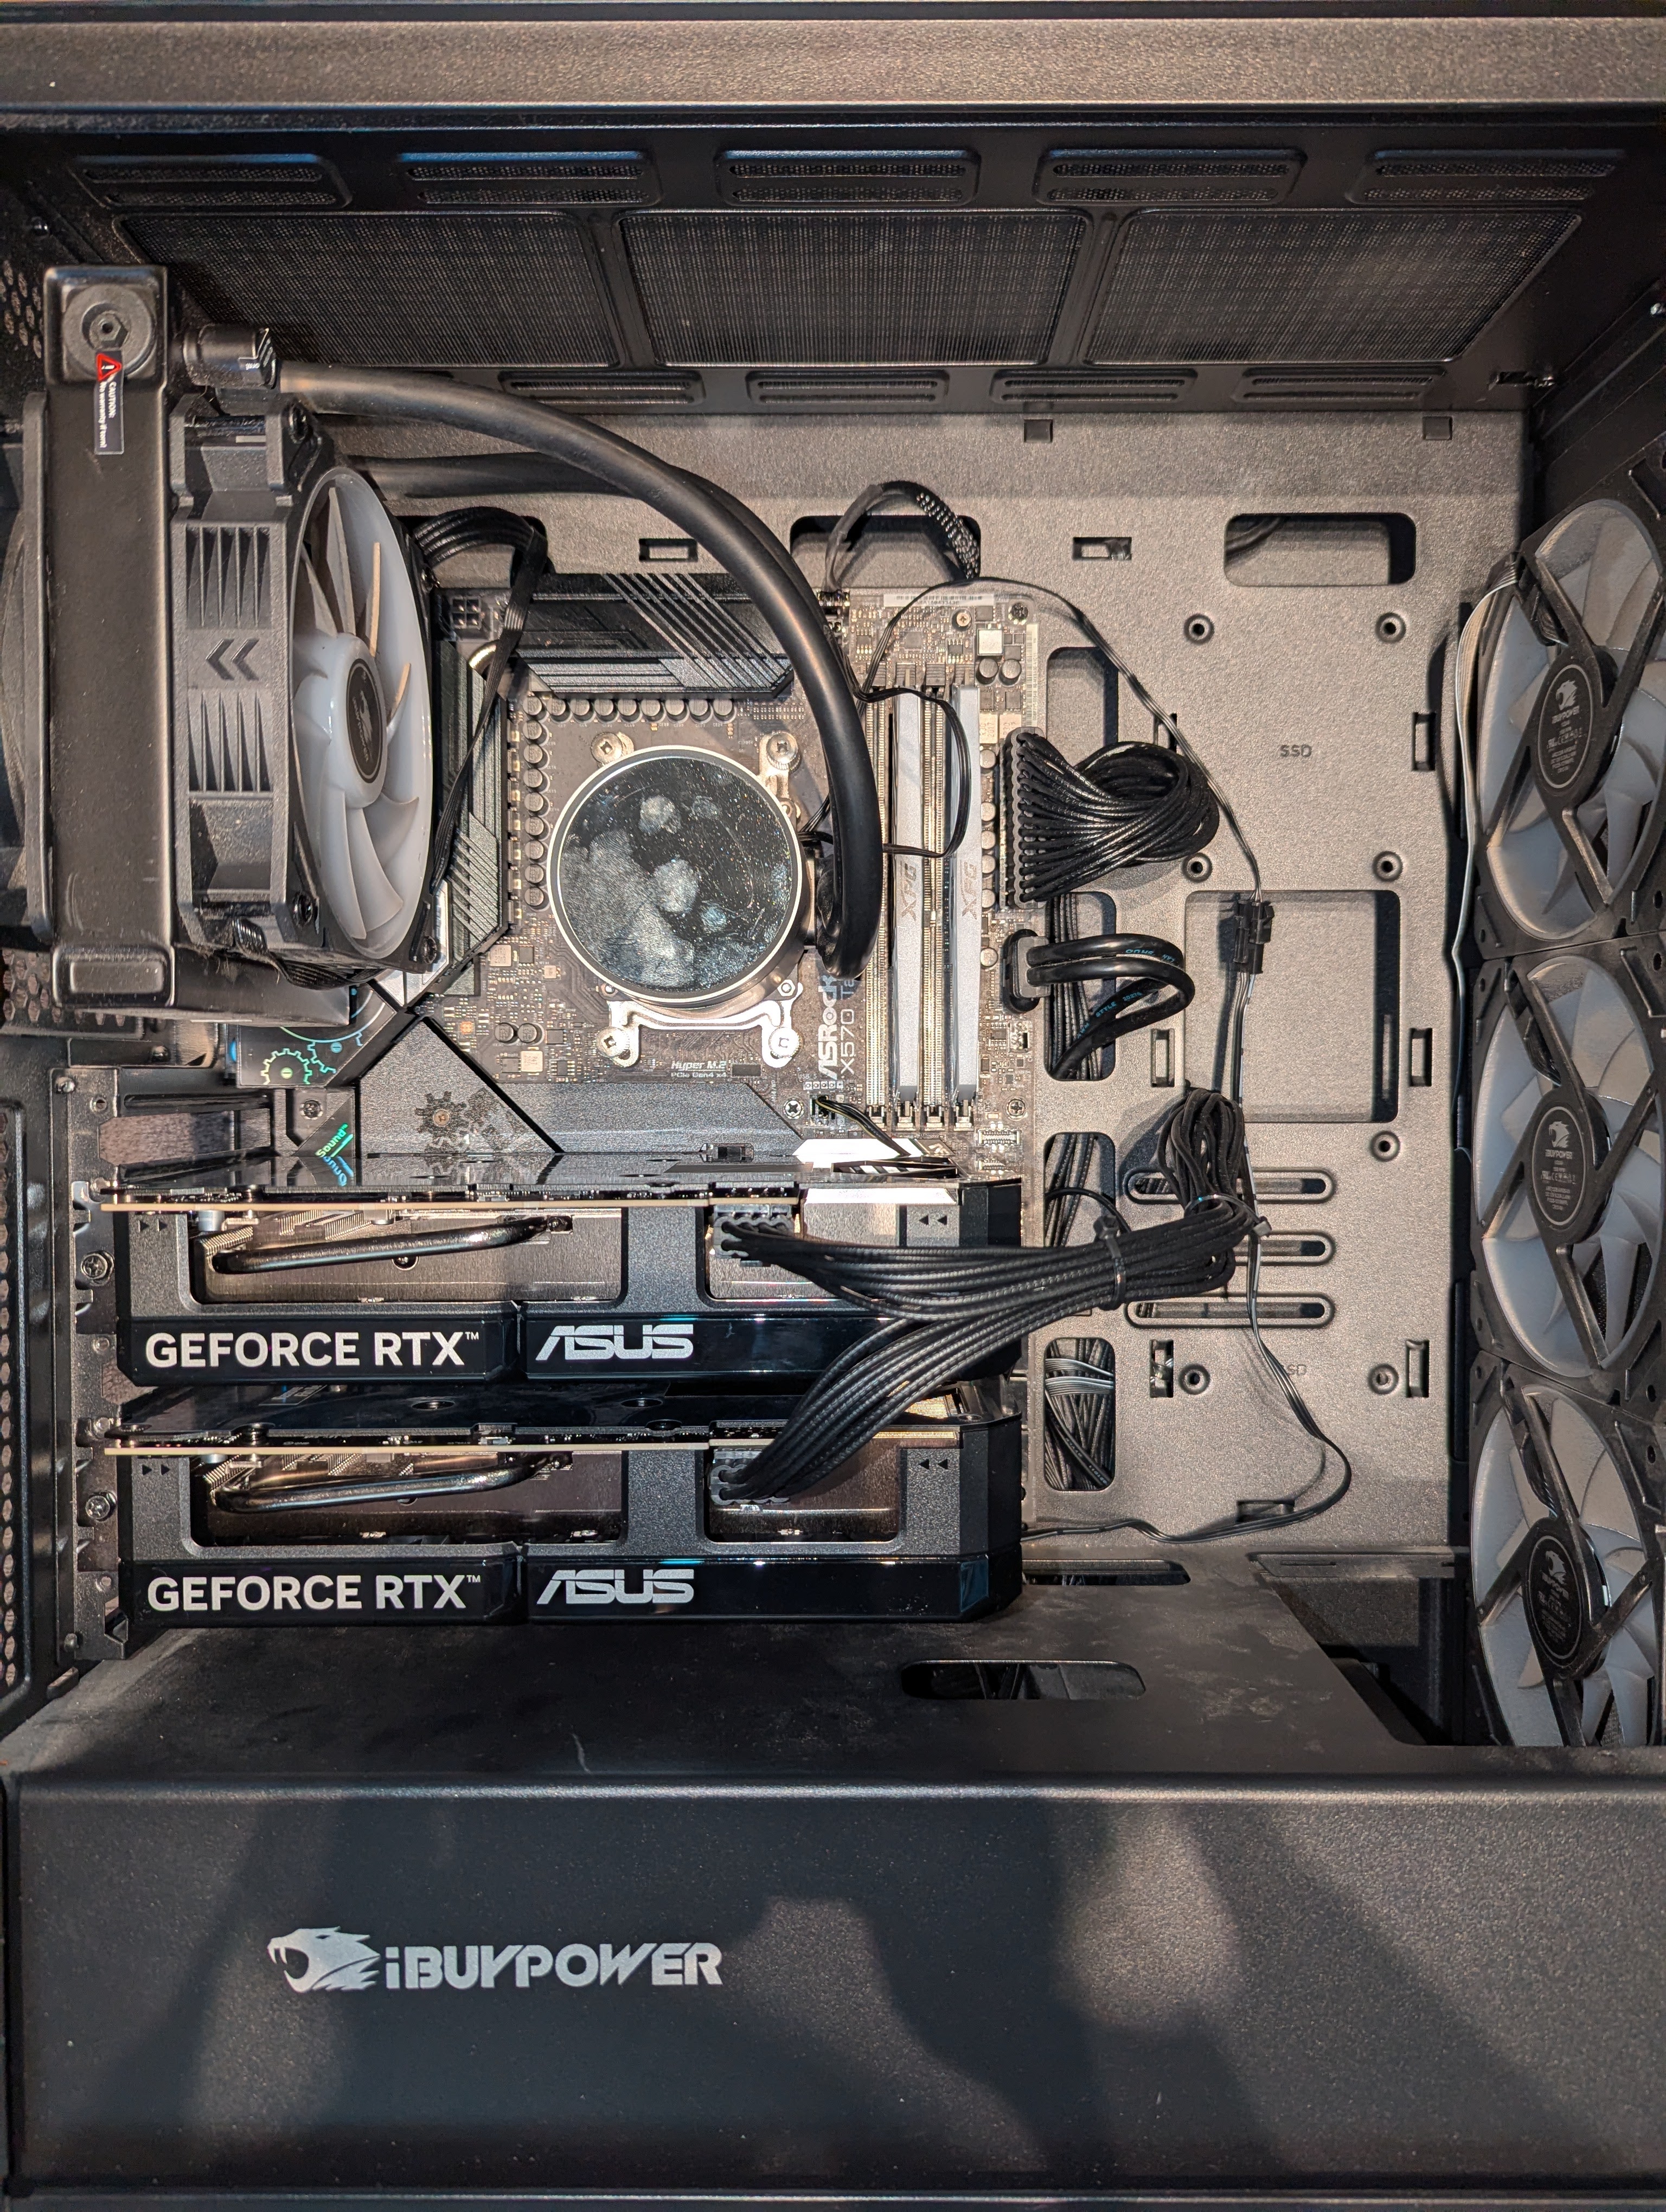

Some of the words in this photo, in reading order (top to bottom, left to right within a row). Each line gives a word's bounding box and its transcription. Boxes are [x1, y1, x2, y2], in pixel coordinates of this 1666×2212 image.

[98, 393, 106, 424] warranty
[108, 381, 117, 419] CAUTION:
[1280, 744, 1312, 757] SSD
[900, 861, 917, 922] XPG
[960, 860, 977, 921] XPG
[841, 979, 855, 1001] Ta
[1095, 1001, 1118, 1017] STYLE
[818, 975, 837, 1081] ASRock
[841, 1008, 855, 1075] X570
[671, 1060, 704, 1071] Hyper
[707, 1060, 727, 1069] M.2
[145, 1332, 360, 1368] GEFORCE
[535, 1324, 694, 1361] ASUS
[1286, 1364, 1308, 1376] SD
[148, 1575, 362, 1611] GEFORCE
[537, 1568, 695, 1605] ASUS
[386, 1943, 723, 1990] iBUYPOWER
